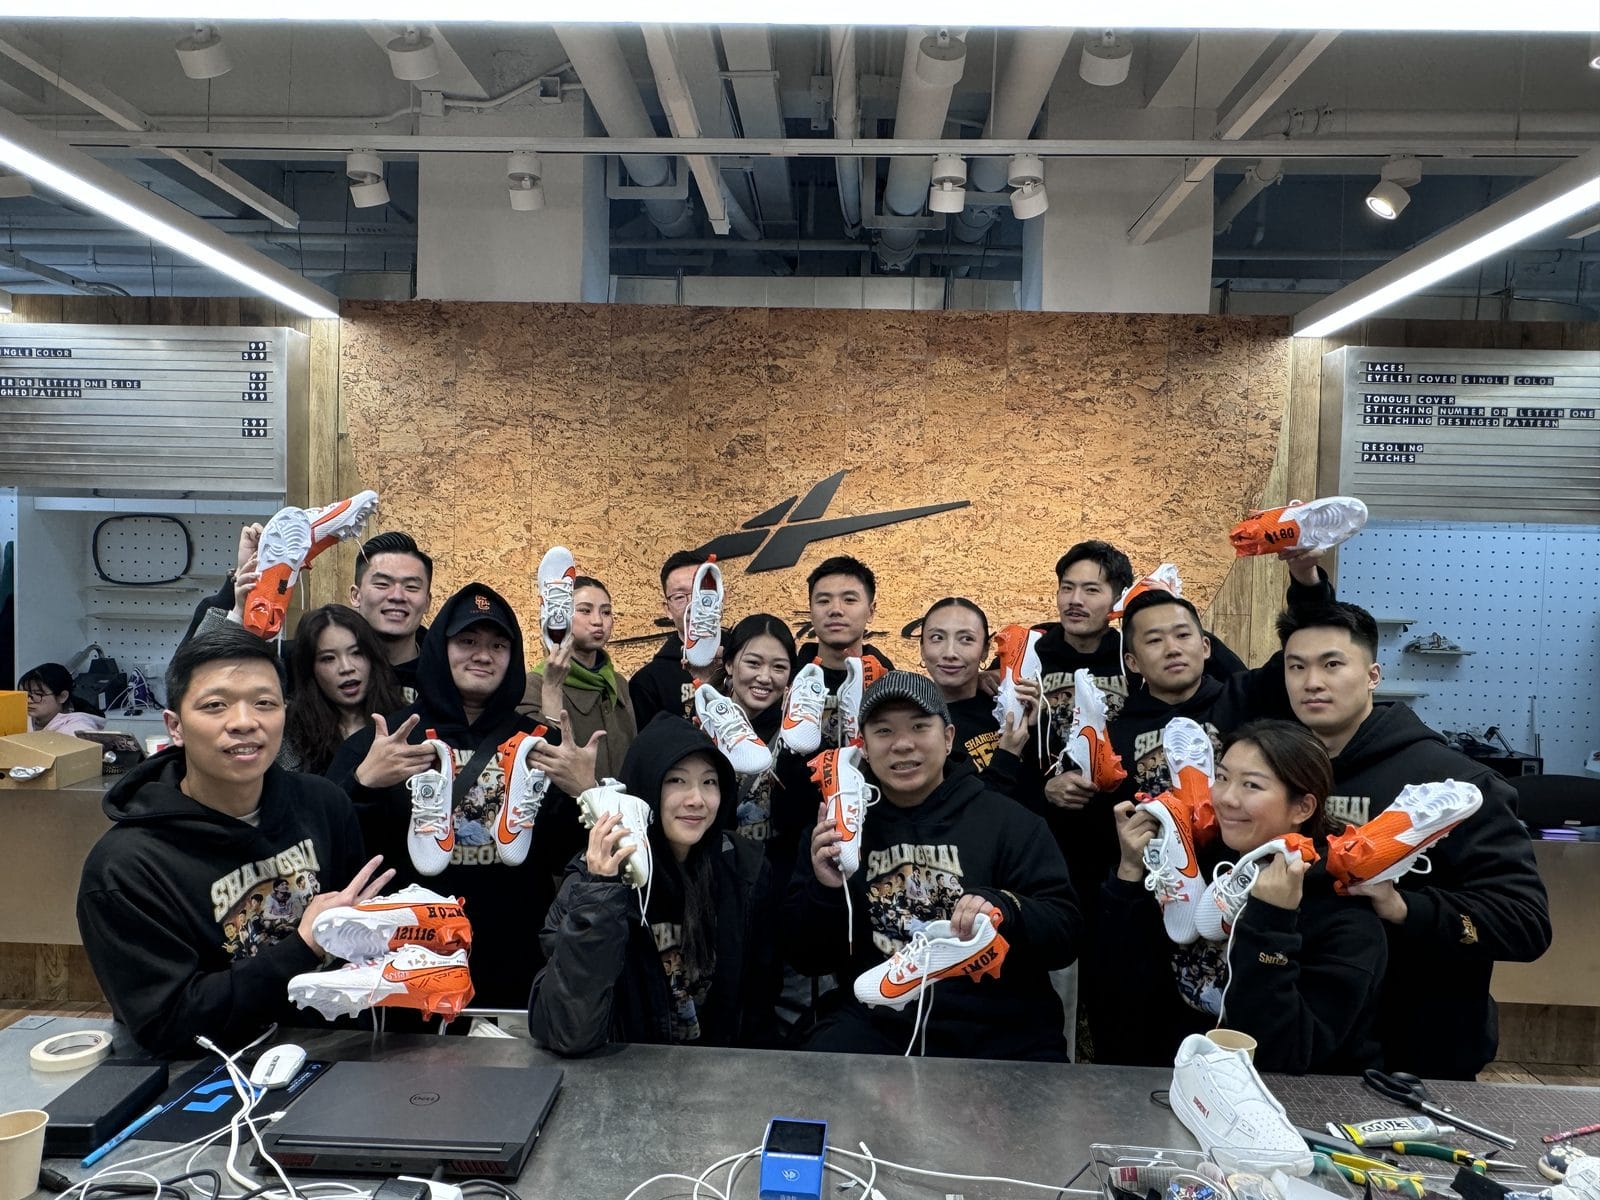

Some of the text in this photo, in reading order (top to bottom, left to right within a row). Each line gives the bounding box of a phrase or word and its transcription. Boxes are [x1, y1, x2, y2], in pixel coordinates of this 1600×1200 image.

[250, 342, 265, 350] 99
[36, 349, 70, 357] COLOR
[243, 352, 265, 360] 399
[1368, 363, 1404, 372] LACES
[0, 378, 13, 386] ER
[85, 380, 105, 388] ONE
[1367, 374, 1553, 386] EYELET COVER SINGLE COLOR
[0, 388, 80, 397] GNED PATTERN
[1366, 395, 1455, 405] TONGUE COVER
[1365, 405, 1594, 418] STITCHING NUMBER OR LETTER ONE
[243, 419, 265, 427] 299
[1365, 416, 1432, 425] STITCHING
[1505, 419, 1559, 428] PATTERN
[243, 429, 265, 437] 199
[1364, 443, 1423, 452] RESOLING
[1364, 454, 1415, 462] PATCHES
[1043, 672, 1129, 698] SHAHAI
[866, 843, 964, 882] SHANGHAI
